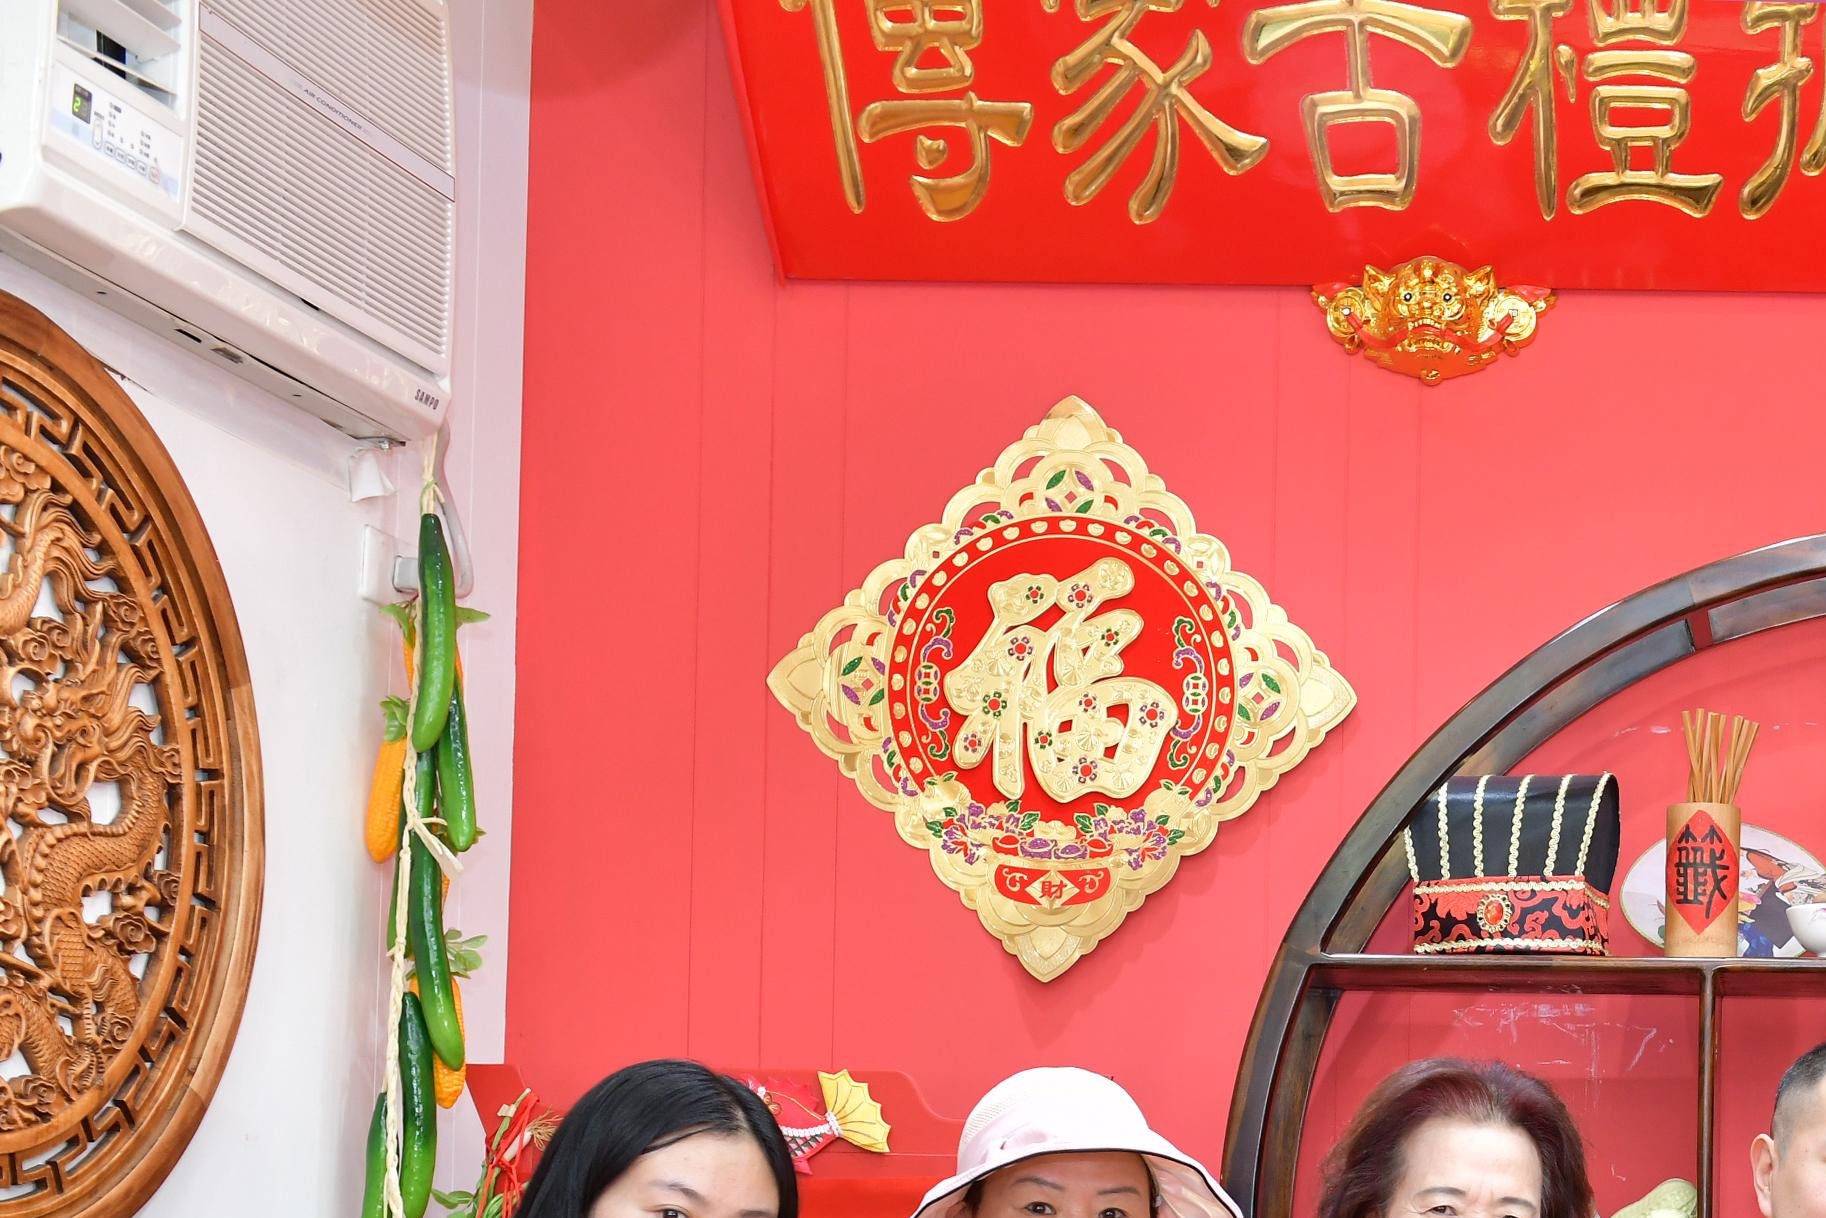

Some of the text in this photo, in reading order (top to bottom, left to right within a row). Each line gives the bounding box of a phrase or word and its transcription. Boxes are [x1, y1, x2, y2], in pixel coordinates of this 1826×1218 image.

[414, 388, 440, 411] SAMPO
[942, 556, 1180, 804] 福
[1040, 880, 1066, 900] 財
